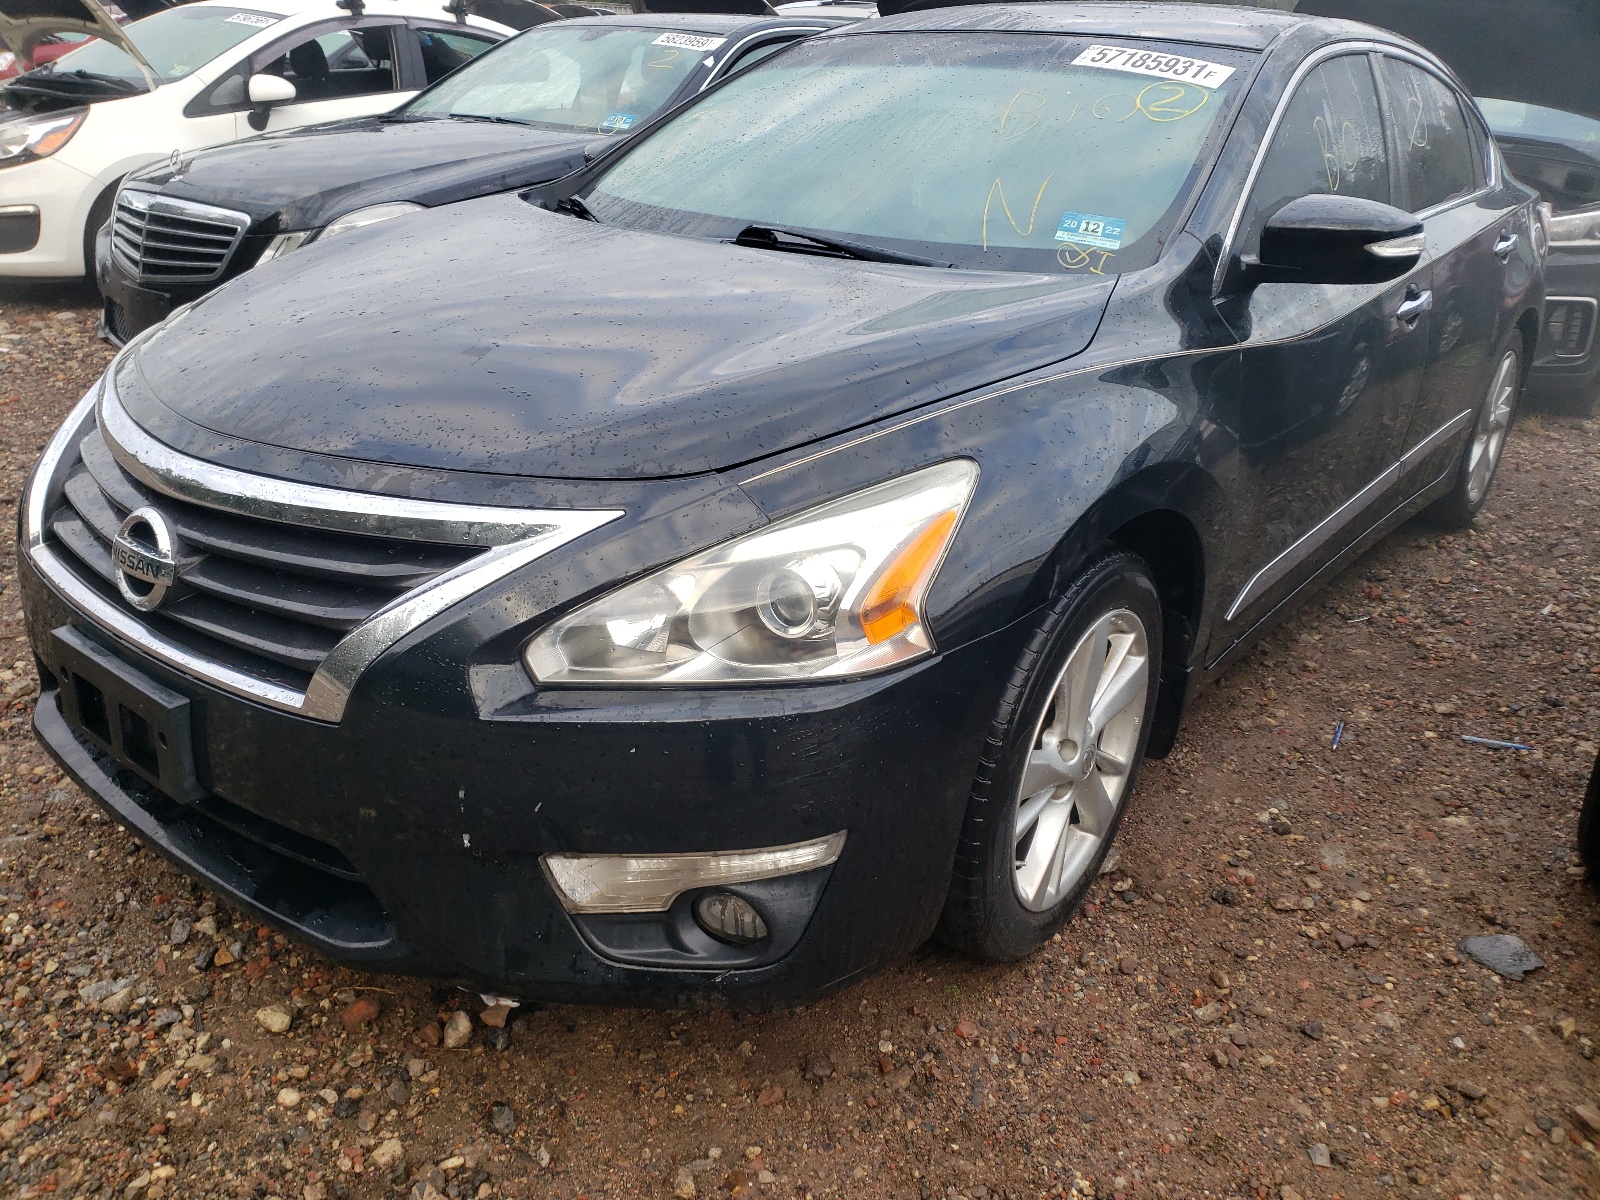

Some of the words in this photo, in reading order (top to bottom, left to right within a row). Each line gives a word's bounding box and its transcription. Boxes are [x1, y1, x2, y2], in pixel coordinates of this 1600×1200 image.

[1062, 219, 1079, 229] 20
[1082, 220, 1101, 234] 12
[1104, 226, 1121, 235] 22
[113, 546, 160, 580] NISSAN
